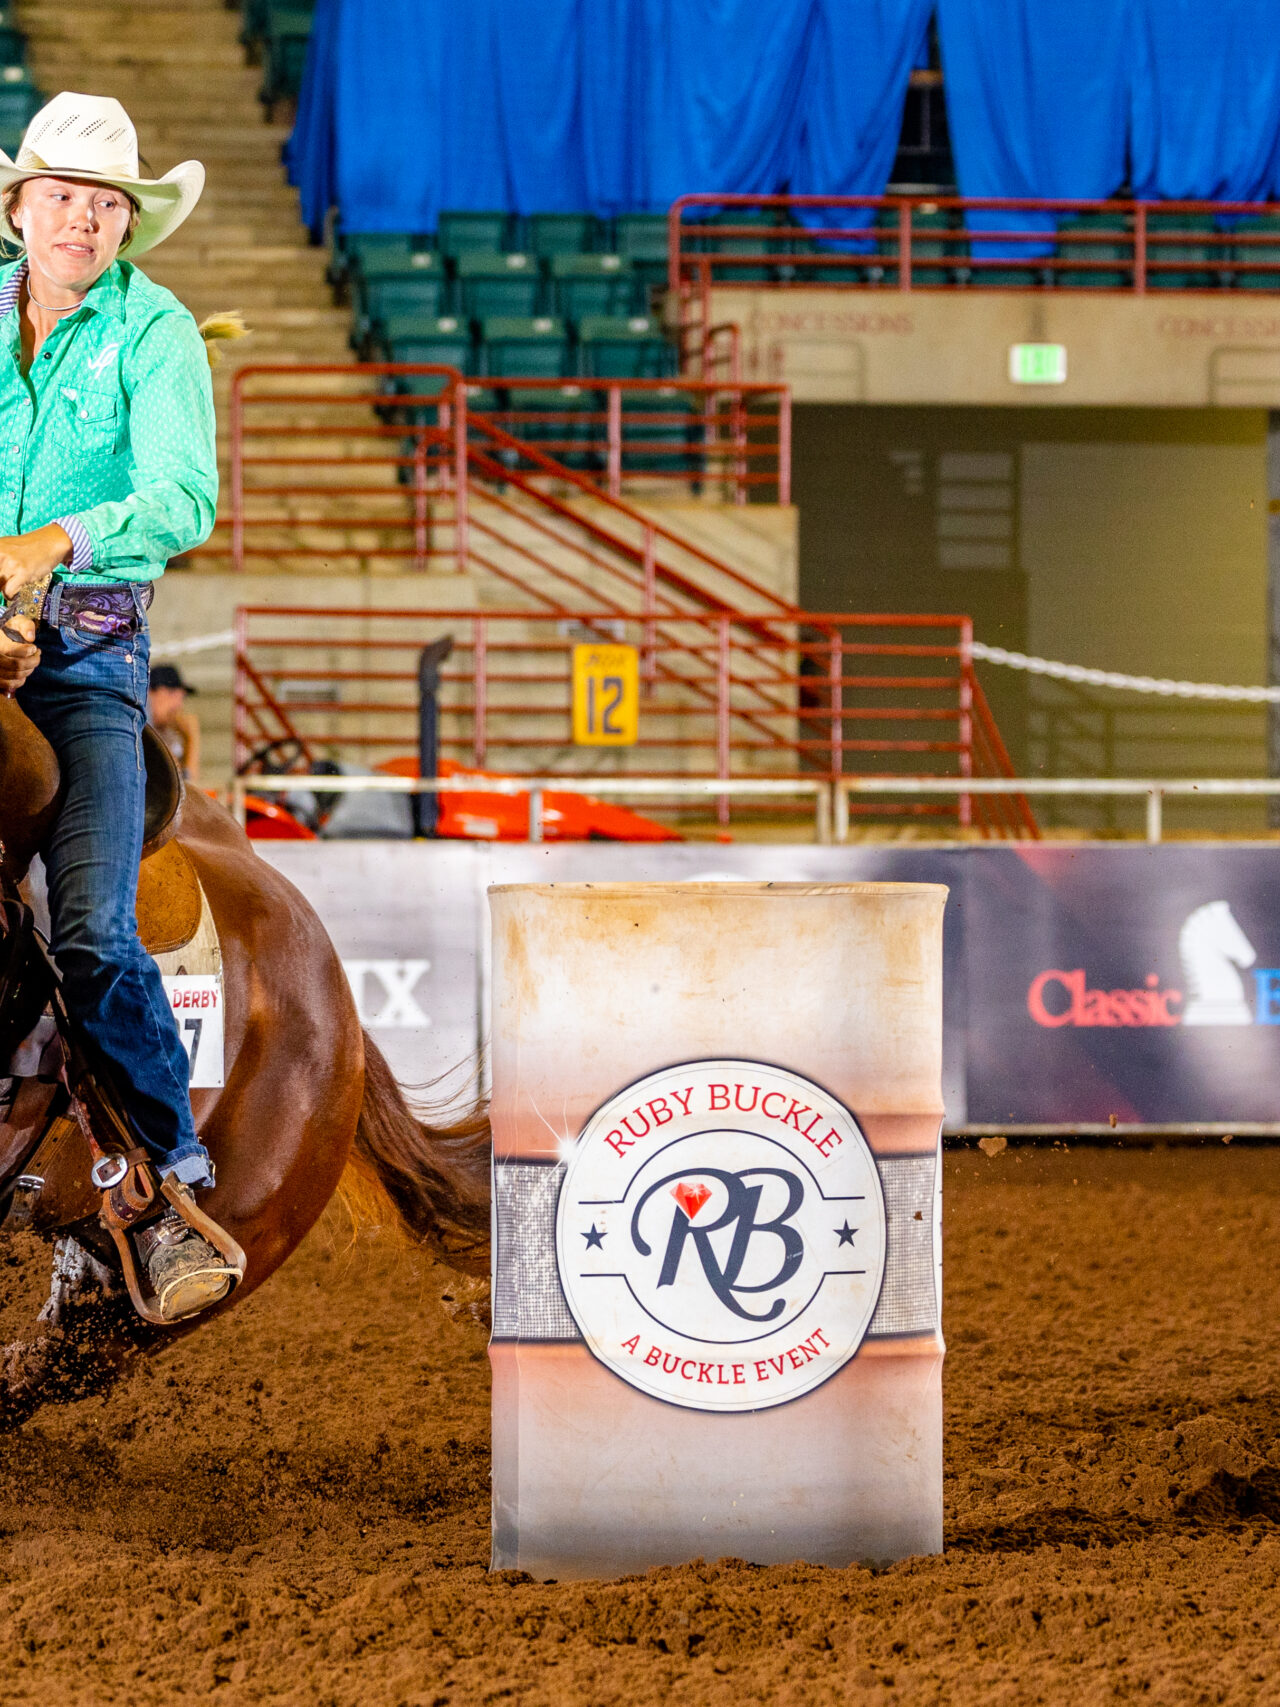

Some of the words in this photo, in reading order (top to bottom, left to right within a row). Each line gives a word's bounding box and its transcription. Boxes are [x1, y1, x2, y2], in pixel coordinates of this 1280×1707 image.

[588, 677, 623, 734] 12
[173, 989, 218, 1008] DERBY
[1027, 968, 1183, 1028] Classic
[175, 1018, 203, 1080] 7
[603, 1087, 695, 1159] RUBY
[707, 1083, 844, 1159] BUCKLE
[630, 1167, 805, 1322] RB
[621, 1333, 640, 1355] A
[643, 1346, 746, 1384] BUCKLE
[753, 1327, 831, 1382] EVENT
